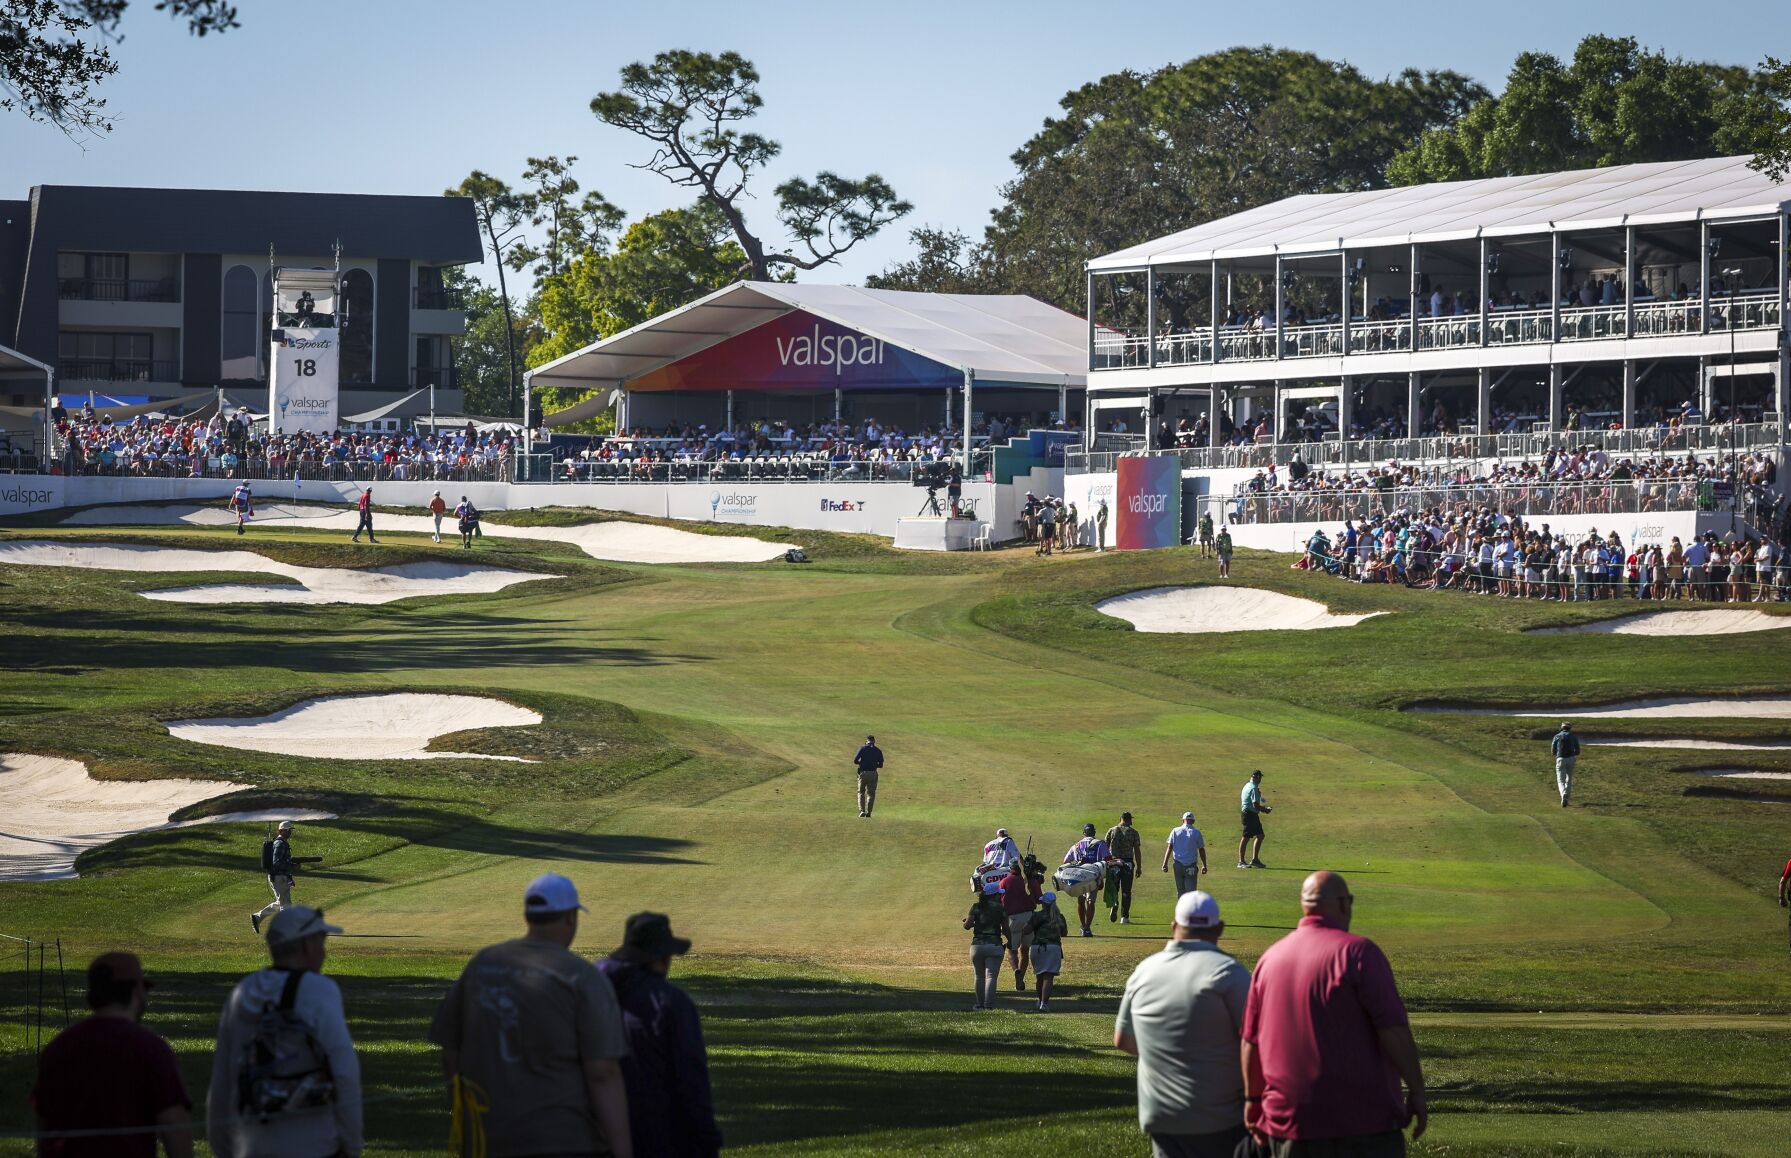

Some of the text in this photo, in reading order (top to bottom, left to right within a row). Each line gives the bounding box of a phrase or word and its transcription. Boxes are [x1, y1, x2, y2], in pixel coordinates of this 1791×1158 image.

[295, 338, 331, 350] Sports
[776, 323, 885, 376] valspar
[294, 359, 317, 377] 18
[291, 396, 330, 411] valspar
[1, 484, 54, 508] valspar
[721, 491, 758, 508] valspar
[1128, 487, 1167, 519] valspar
[829, 500, 856, 512] FedEx
[1639, 523, 1665, 541] valspar
